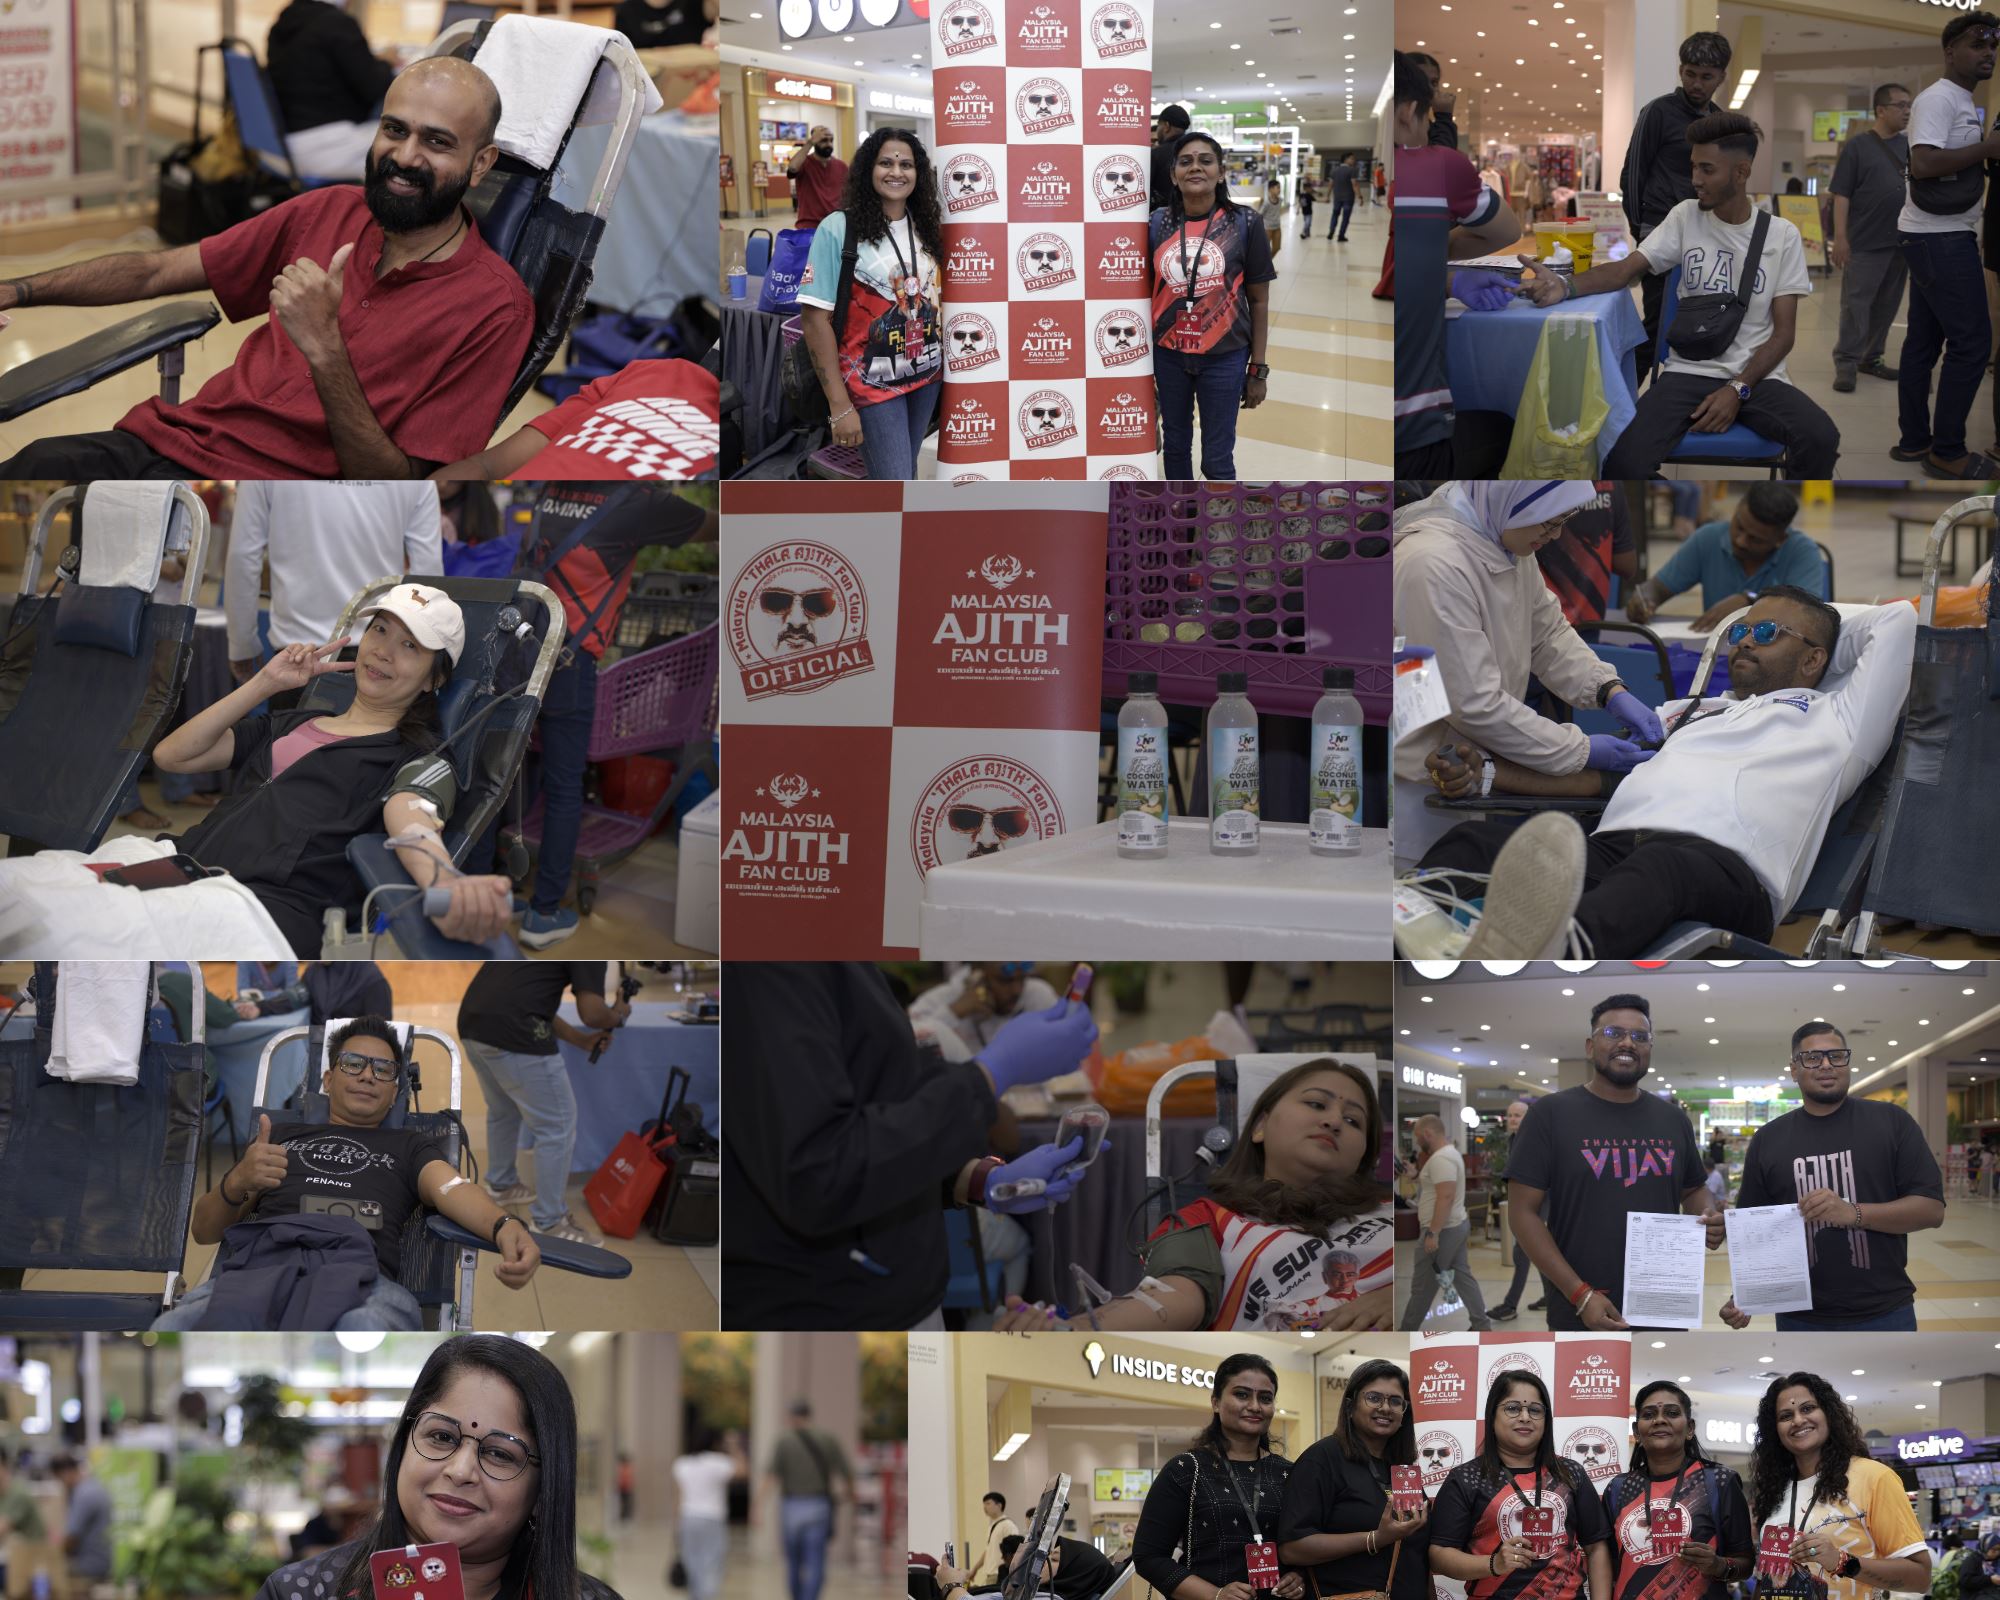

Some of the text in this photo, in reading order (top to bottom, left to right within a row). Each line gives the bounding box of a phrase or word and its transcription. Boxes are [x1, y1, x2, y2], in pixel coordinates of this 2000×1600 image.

[1018, 26, 1069, 38] AJITH
[947, 36, 996, 54] OFFICIAL
[1100, 40, 1146, 57] OFFICIAL
[944, 101, 994, 115] AJITH
[1097, 103, 1145, 116] AJITH
[1025, 115, 1073, 133] OFFICIAL
[1020, 182, 1071, 195] AJITH
[950, 193, 997, 211] OFFICIAL
[1101, 193, 1146, 211] OFFICIAL
[946, 258, 995, 271] AJITH
[1098, 257, 1145, 270] AJITH
[1027, 271, 1074, 290] OFFICIAL
[1021, 338, 1072, 351] AJITH
[950, 350, 998, 370] OFFICIAL
[1102, 346, 1148, 366] OFFICIAL
[945, 419, 996, 433] AJITH
[1099, 413, 1148, 426] AJITH
[1028, 428, 1077, 448] OFFICIAL
[951, 594, 1053, 609] MALAYSIA
[932, 612, 1070, 646] AJITH
[951, 648, 1048, 663] FAN CLUB
[749, 647, 869, 690] OFFICIAL
[1127, 781, 1165, 789] WATER
[1318, 778, 1357, 788] WATER
[740, 811, 835, 828] MALAYSIA
[721, 829, 850, 864] AJITH
[740, 865, 831, 882] FAN CLUB
[1583, 1139, 1672, 1147] THALAPATHY
[313, 1153, 354, 1164] HOTEL
[1580, 1148, 1676, 1188] VIJAY
[305, 1177, 352, 1188] PENANG
[1112, 1354, 1178, 1383] INSIDE
[1424, 1373, 1459, 1381] MALAYSIA
[1569, 1375, 1620, 1388] AJITH
[1418, 1380, 1465, 1394] AJITH
[1898, 1435, 1964, 1460] tealive
